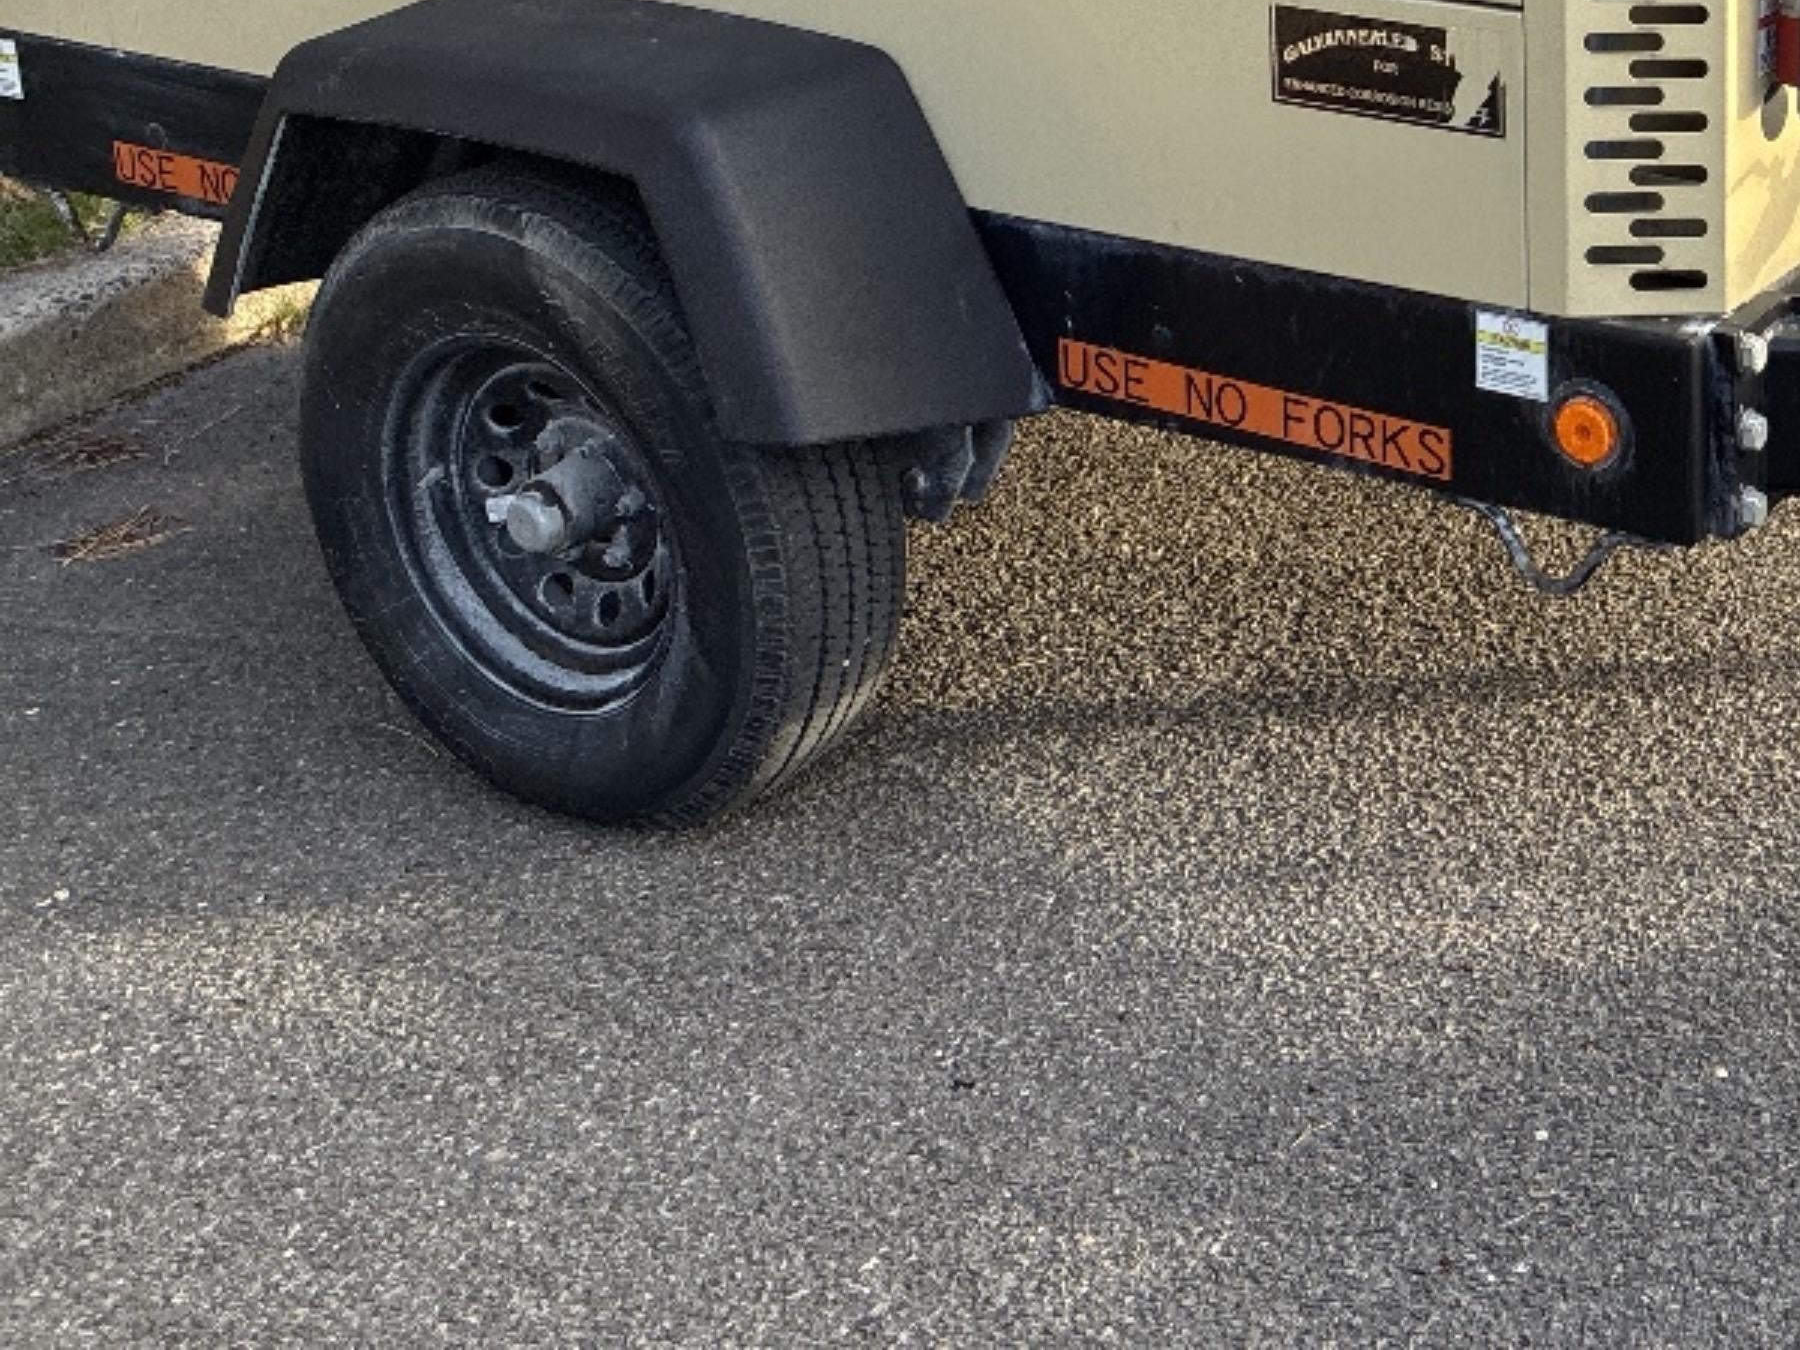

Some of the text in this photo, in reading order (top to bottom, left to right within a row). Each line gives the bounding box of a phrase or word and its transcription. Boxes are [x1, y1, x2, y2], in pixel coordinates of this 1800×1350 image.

[114, 144, 180, 193] USE
[1062, 343, 1447, 476] USE NO FORKS
